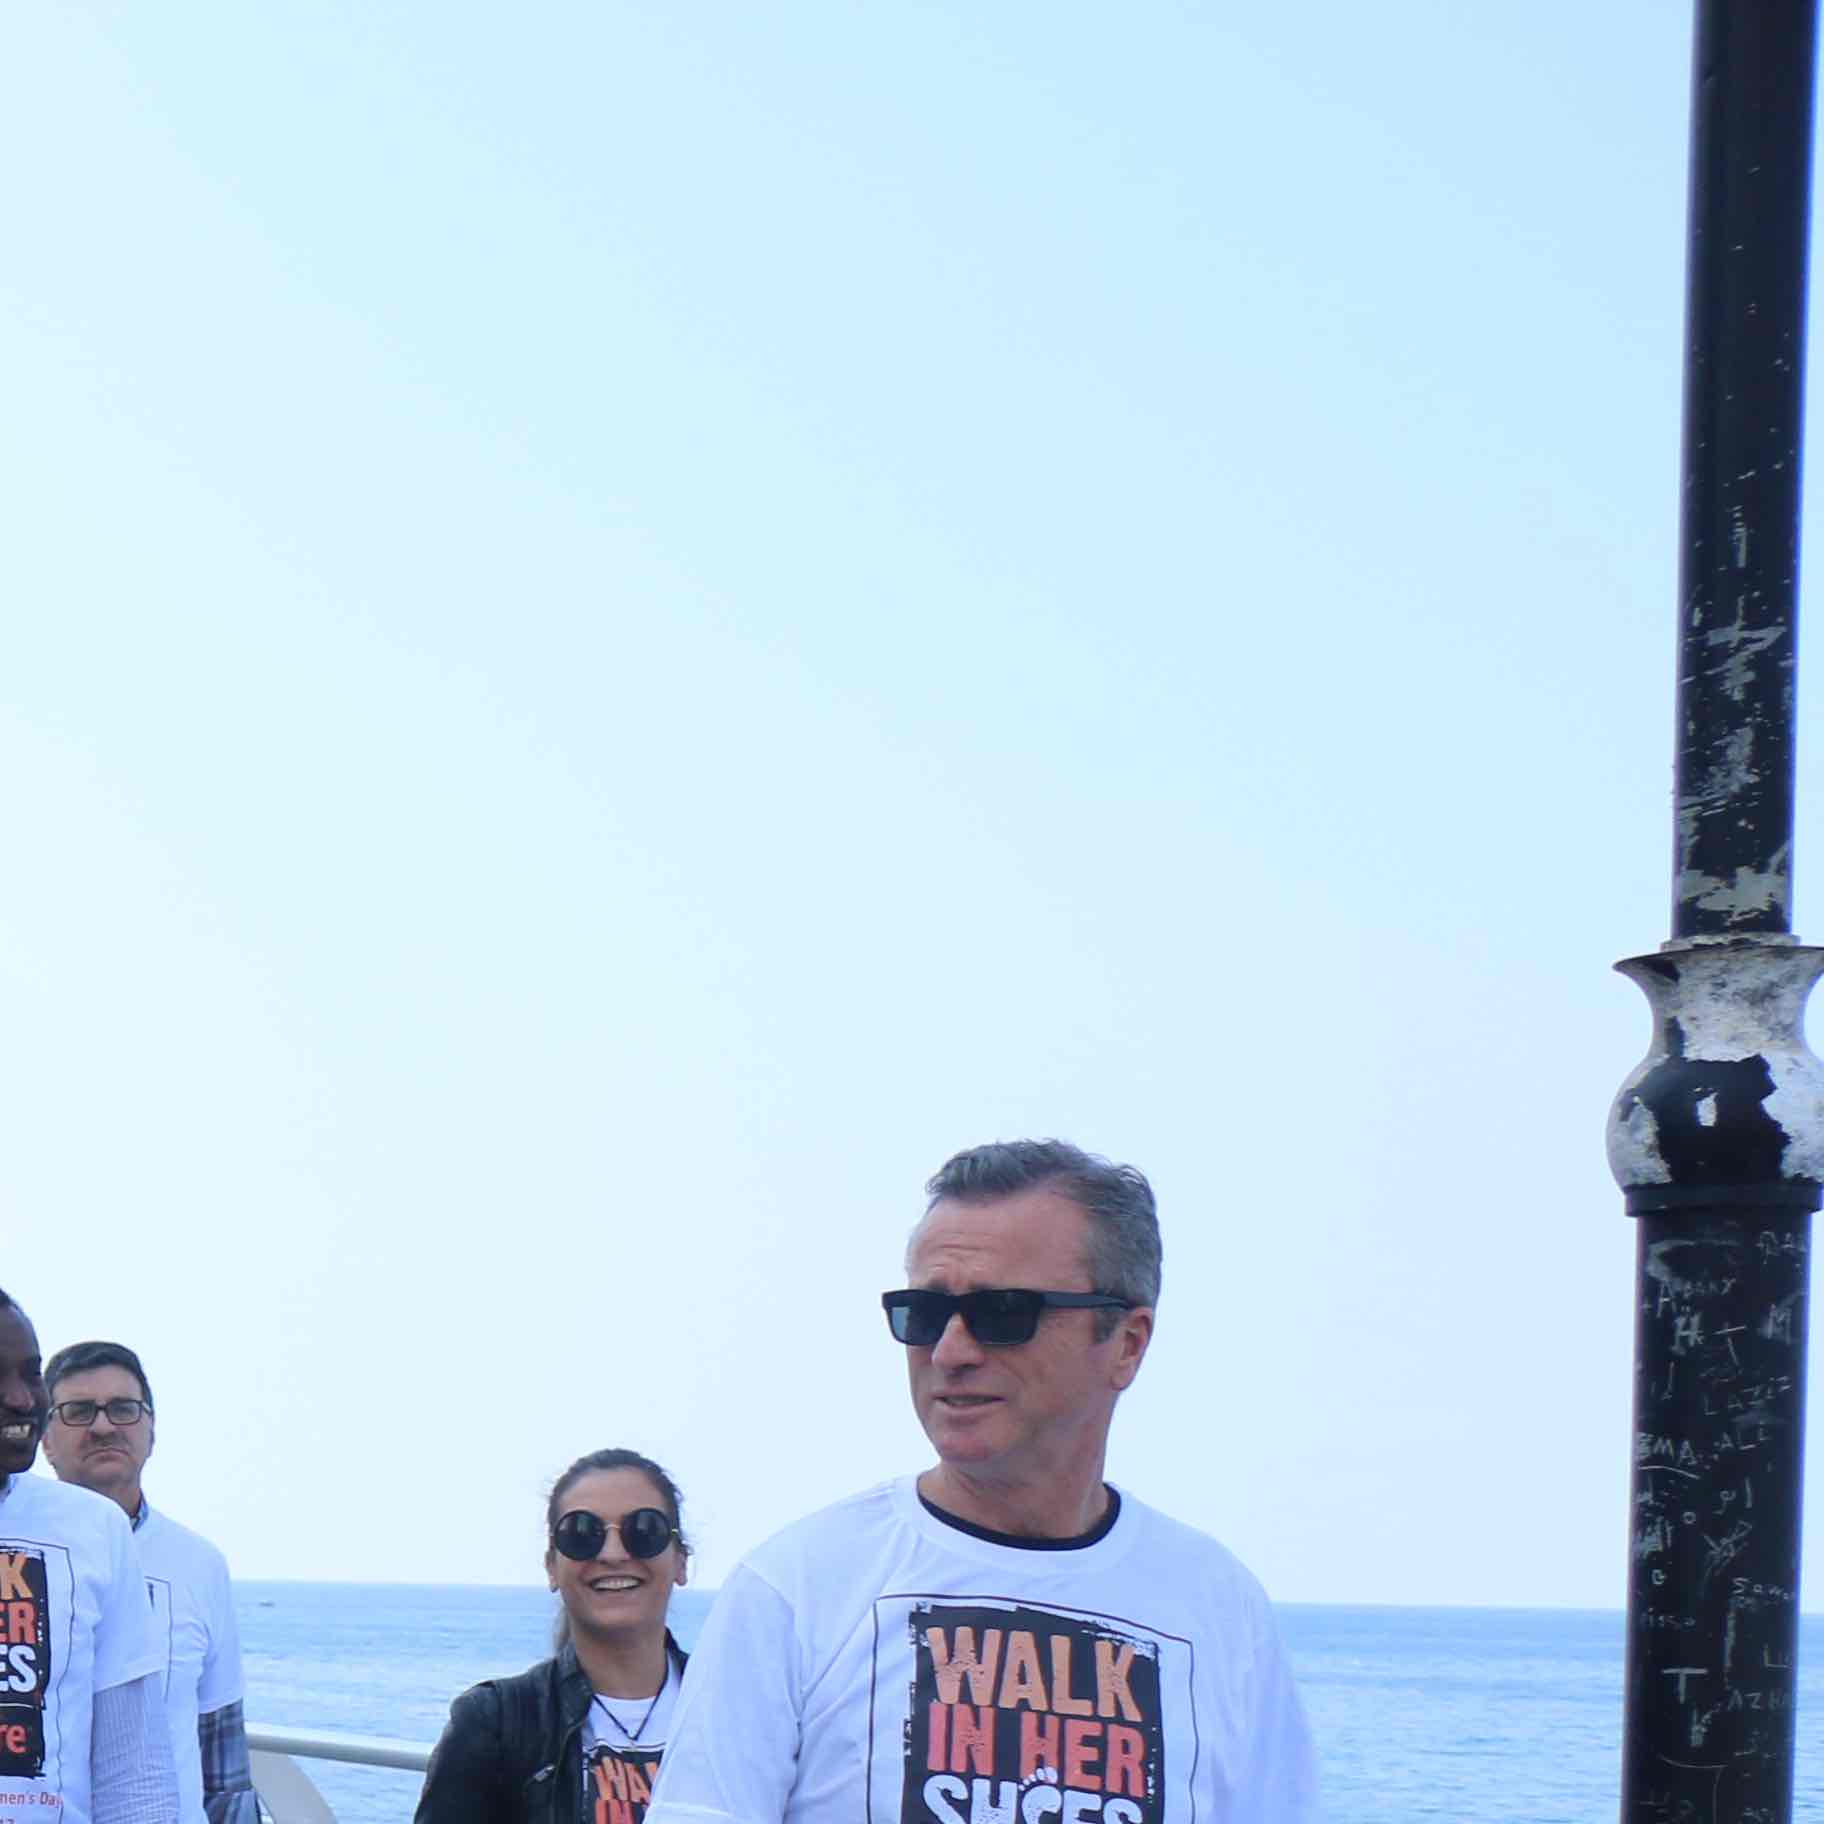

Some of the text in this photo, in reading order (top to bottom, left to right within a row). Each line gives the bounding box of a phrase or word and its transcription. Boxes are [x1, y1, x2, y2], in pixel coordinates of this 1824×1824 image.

[925, 1625, 1144, 1722] WALK
[926, 1701, 1147, 1798] IN HER
